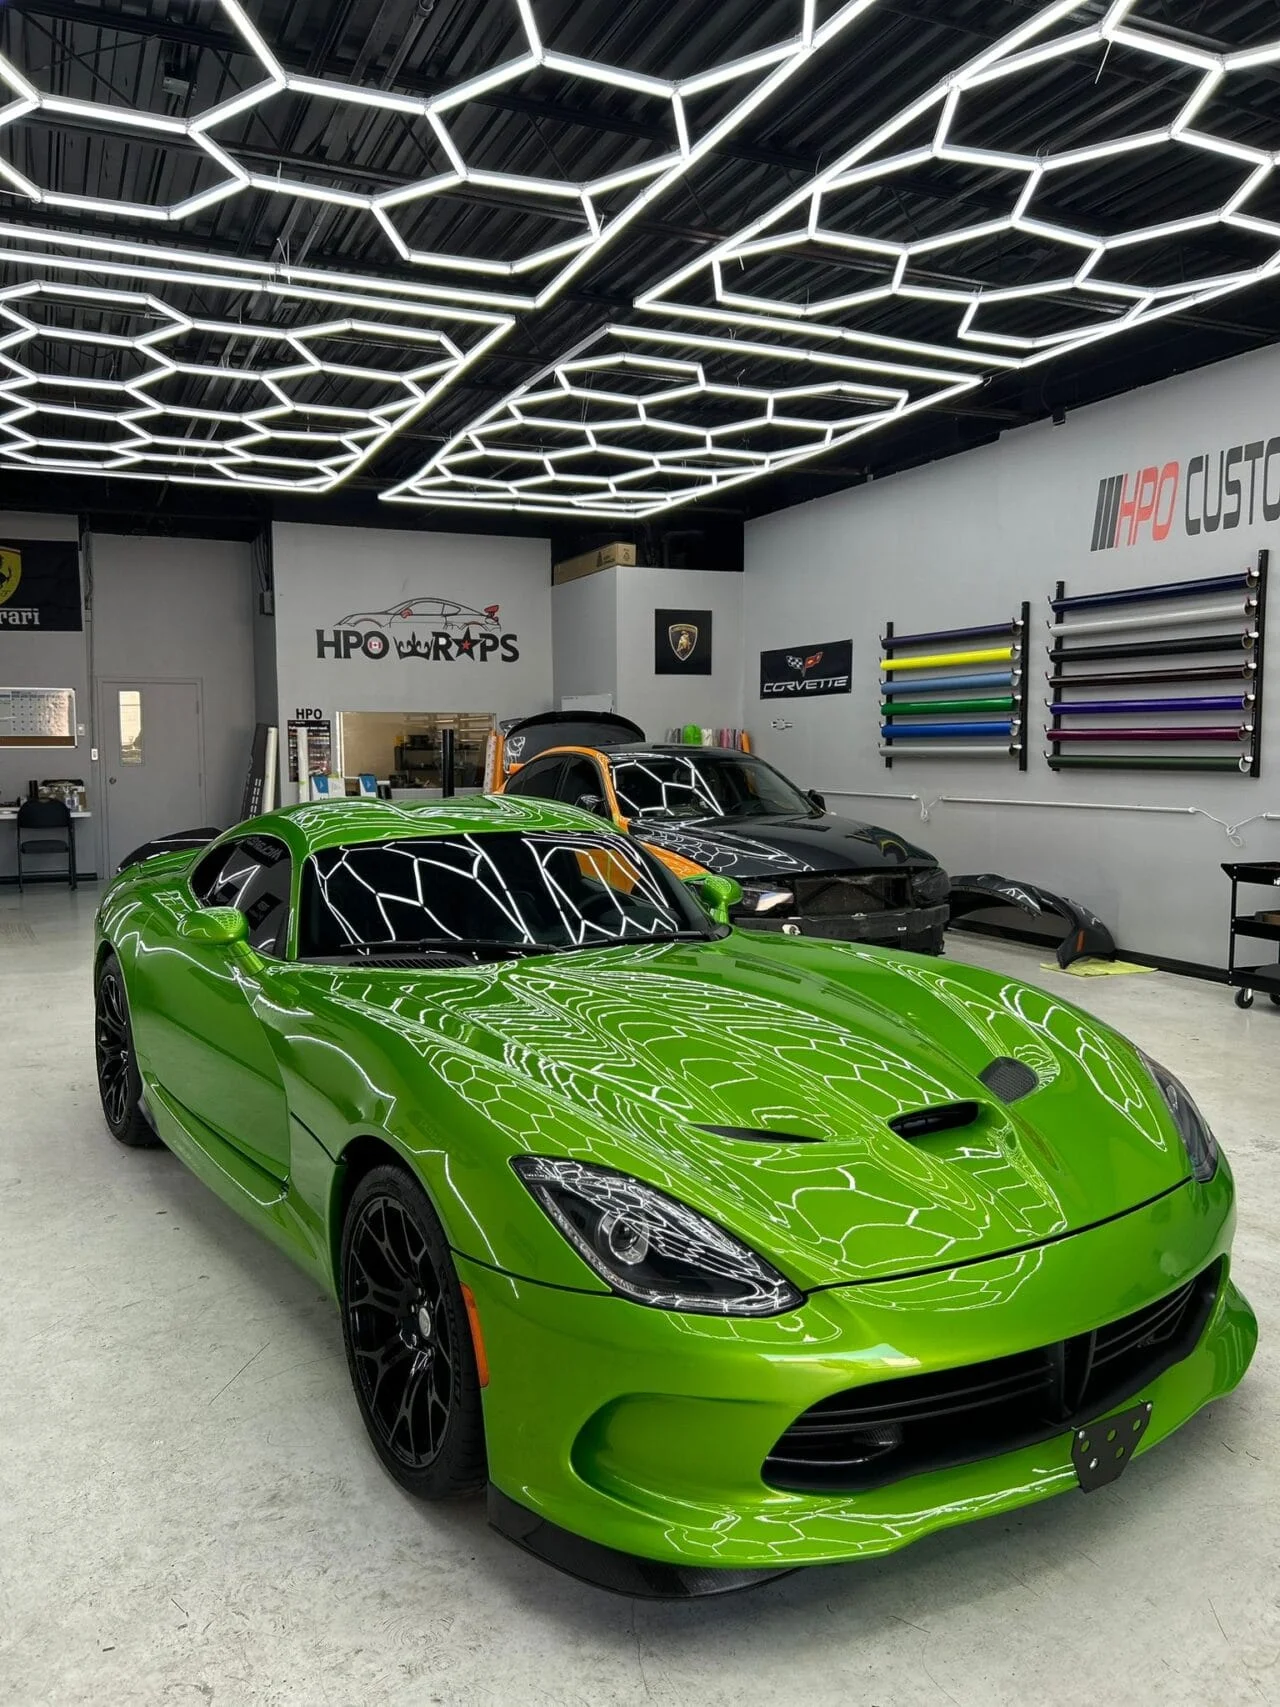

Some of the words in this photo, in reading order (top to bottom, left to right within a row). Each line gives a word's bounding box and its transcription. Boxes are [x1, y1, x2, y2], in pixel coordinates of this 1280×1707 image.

[1114, 461, 1180, 548] HPO
[316, 629, 390, 660] HPO
[763, 675, 849, 693] CORVETTE
[295, 707, 322, 720] HPO
